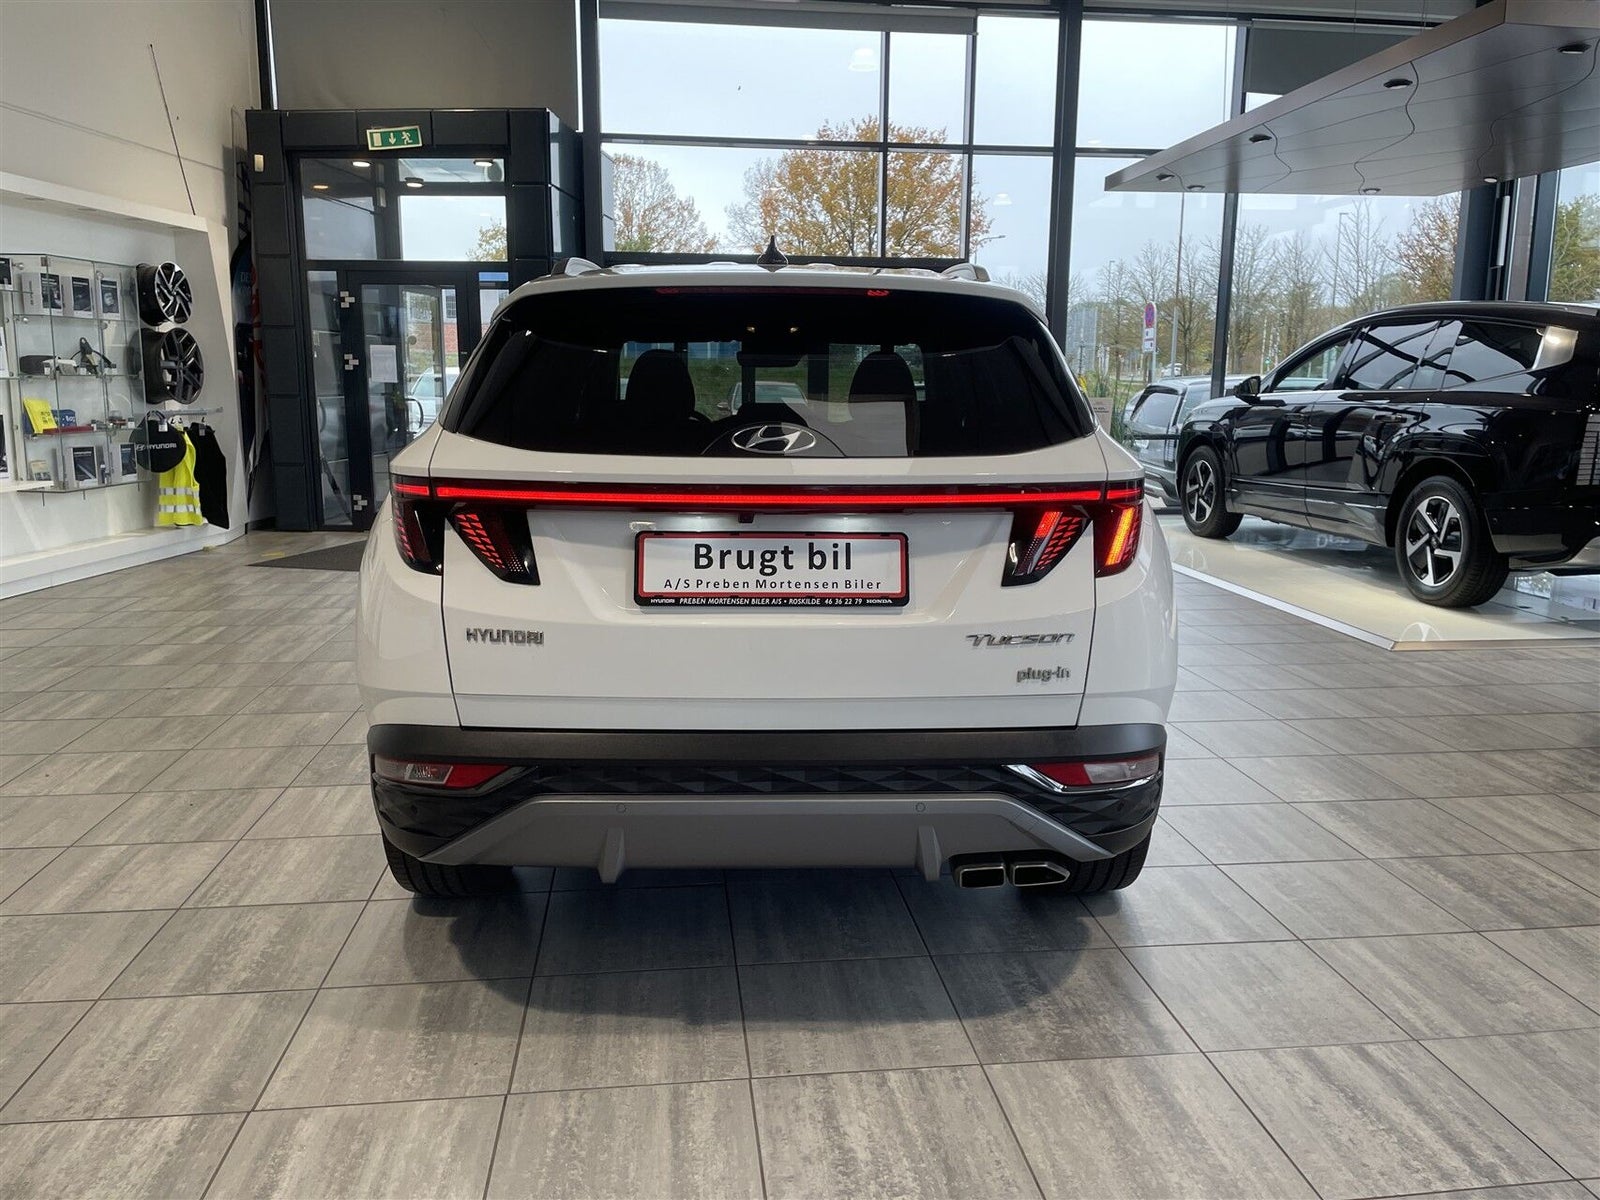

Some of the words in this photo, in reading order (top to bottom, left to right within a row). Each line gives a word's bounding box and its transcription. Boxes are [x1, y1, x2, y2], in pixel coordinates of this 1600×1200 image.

[694, 543, 794, 576] Brugt
[808, 542, 851, 570] bil
[663, 578, 690, 590] A/S
[696, 579, 749, 589] Preben
[755, 579, 839, 590] Mortensen
[844, 579, 881, 590] Biler
[679, 598, 706, 606] PREBEN
[707, 598, 750, 606] MORTENSEN
[751, 598, 770, 606] BILER
[771, 598, 782, 606] A/S
[788, 598, 821, 606] ROSKILDE
[825, 598, 833, 606] 46
[834, 598, 843, 606] 36
[844, 598, 853, 606] 22
[854, 598, 863, 606] 79
[466, 628, 544, 645] HYUNDAI
[1016, 666, 1071, 683] plug-in
